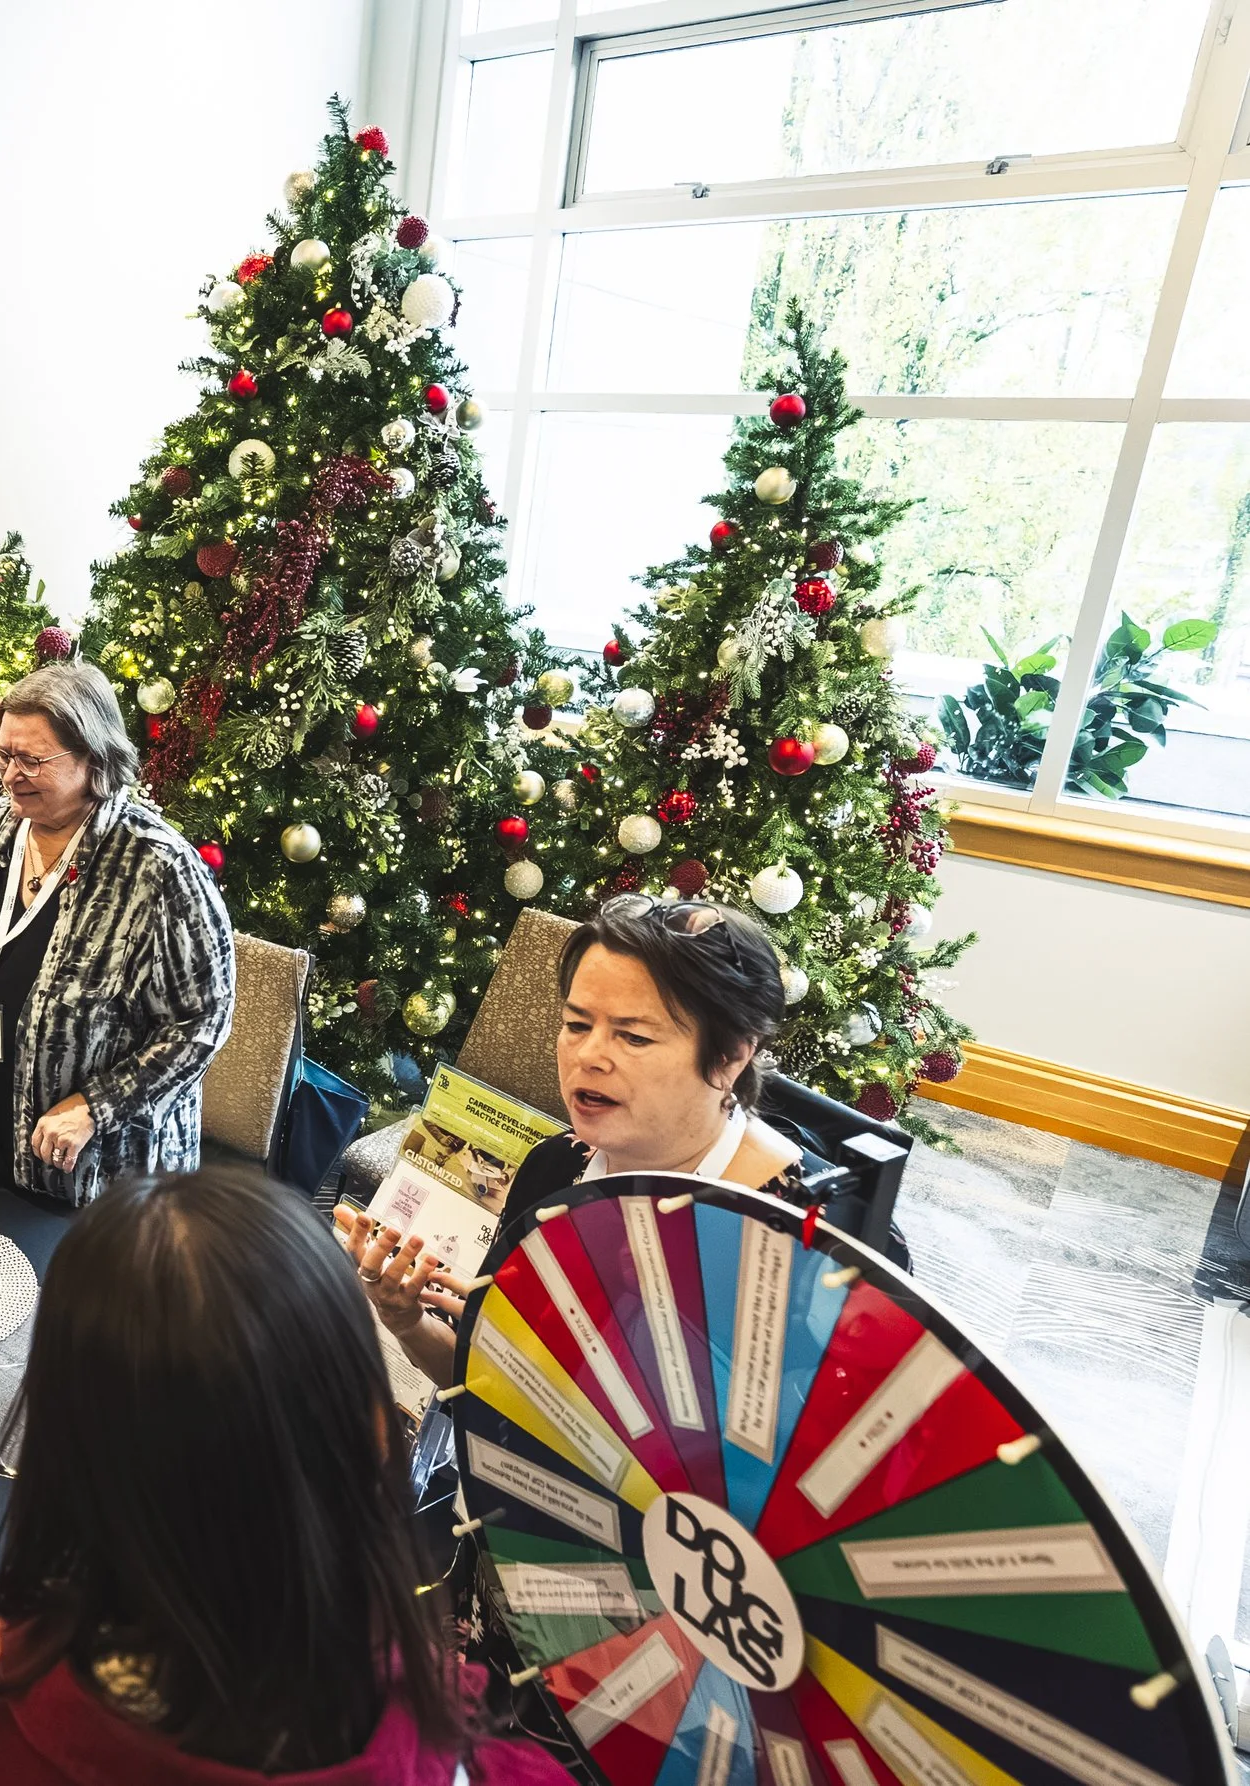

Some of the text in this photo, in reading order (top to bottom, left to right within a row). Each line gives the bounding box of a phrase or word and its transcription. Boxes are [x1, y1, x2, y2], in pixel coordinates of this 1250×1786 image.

[465, 1104, 501, 1128] PRACTICE
[468, 1097, 497, 1116] CAREER
[497, 1112, 548, 1140] DEVELOPMEN
[404, 1149, 463, 1188] CUSTOMIZED
